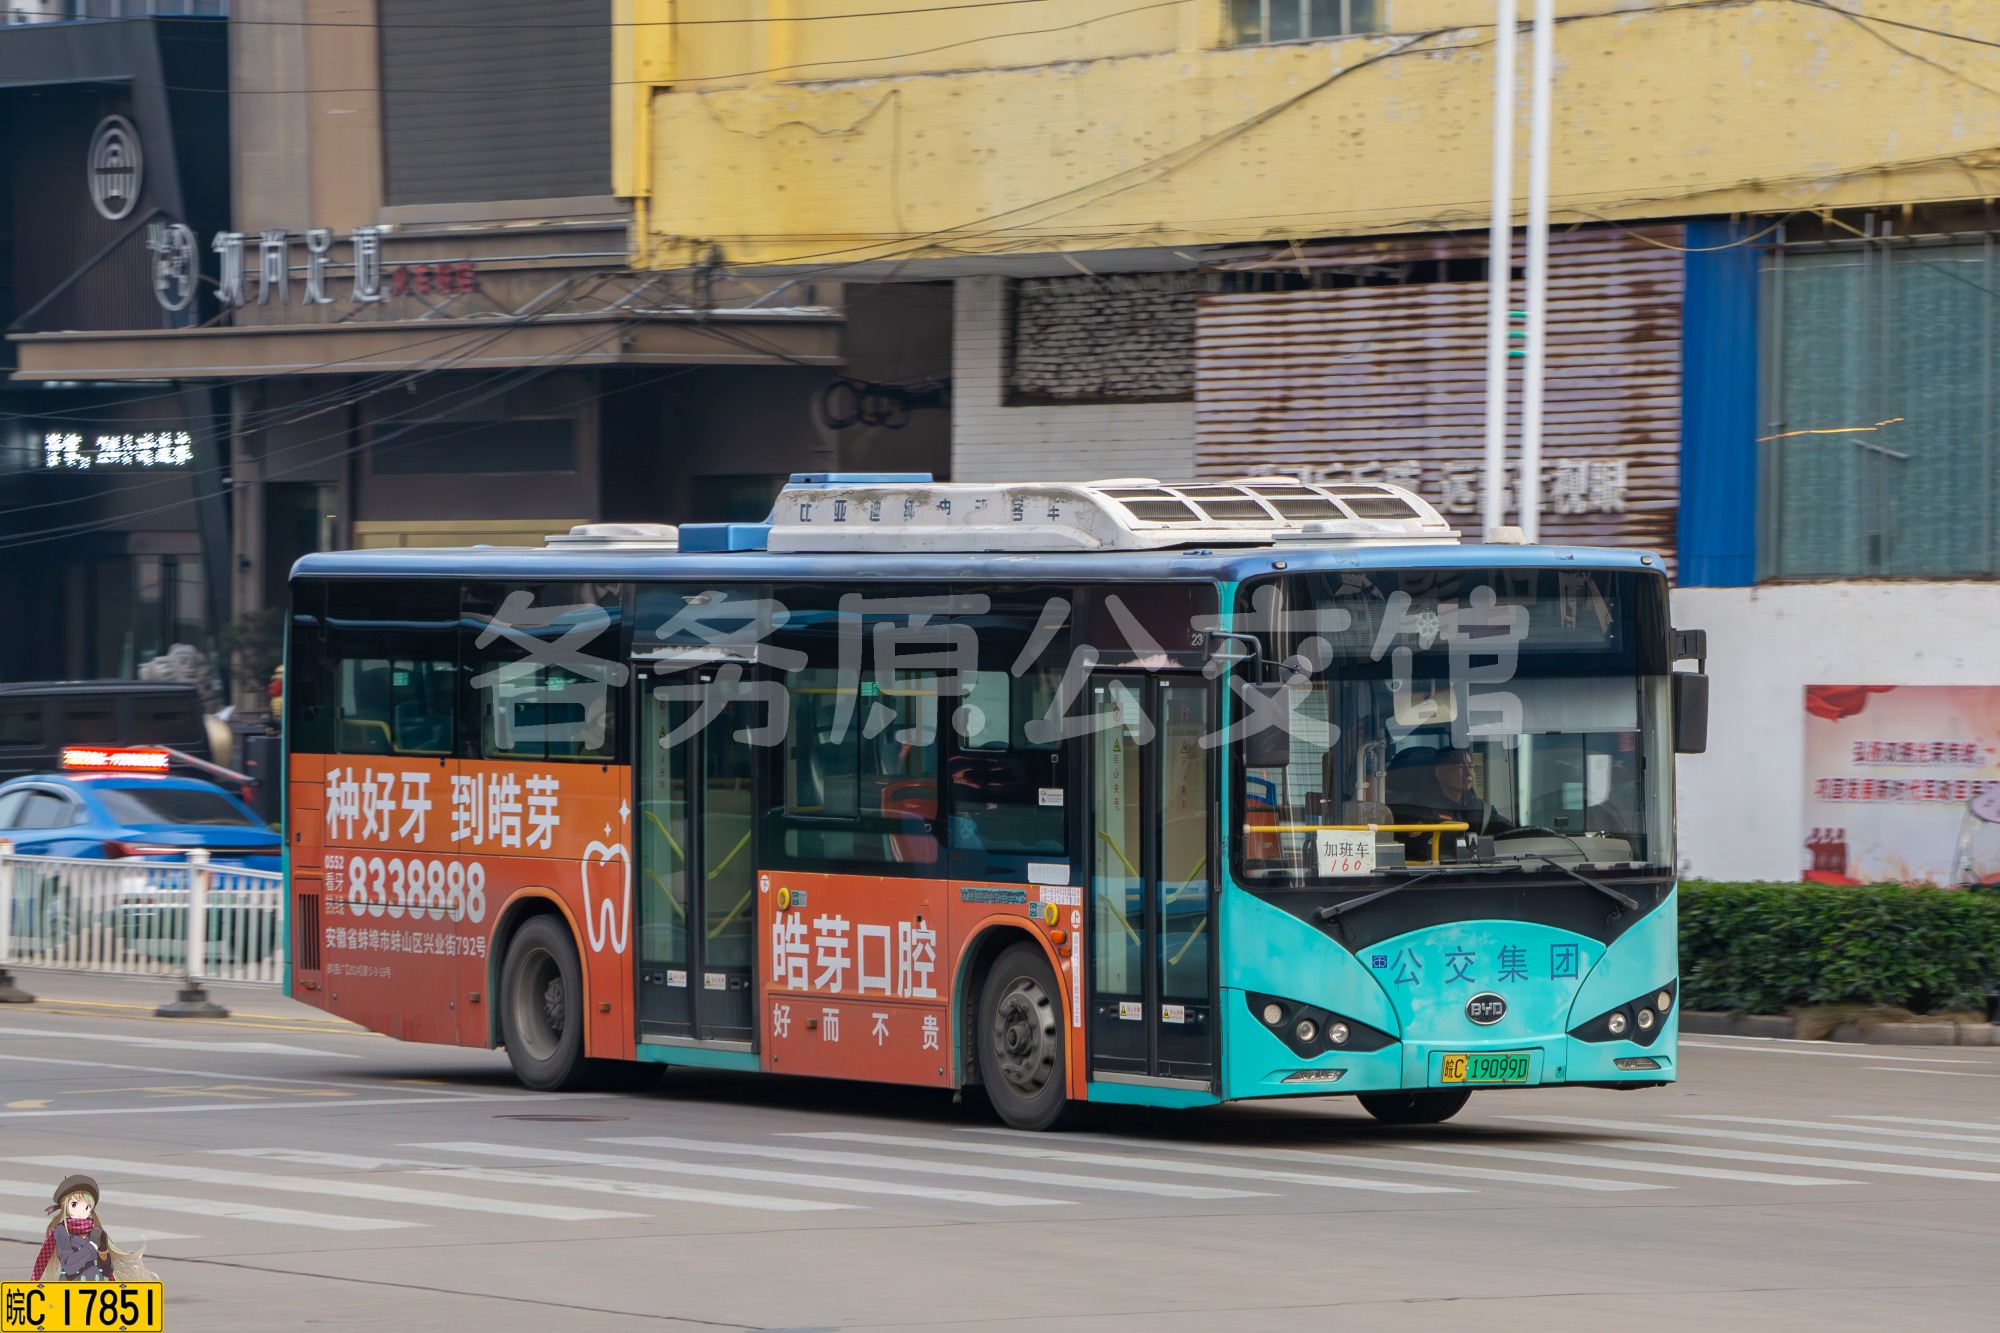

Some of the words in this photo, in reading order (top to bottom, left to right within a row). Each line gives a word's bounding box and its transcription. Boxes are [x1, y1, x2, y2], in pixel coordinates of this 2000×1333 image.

[325, 766, 432, 844] 种好牙
[450, 772, 560, 850] 到皓芽
[324, 855, 345, 870] 0552
[1324, 841, 1370, 859] 加班车
[1331, 857, 1362, 873] 160
[348, 855, 486, 924] 8338888
[325, 926, 487, 959] 安徽省蚌埠市蚌山区兴业街792号
[772, 910, 937, 999] 皓芽口腔
[1389, 943, 1579, 986] 公交集团
[773, 1002, 940, 1051] 好而不贵
[1471, 1002, 1503, 1017] BYD
